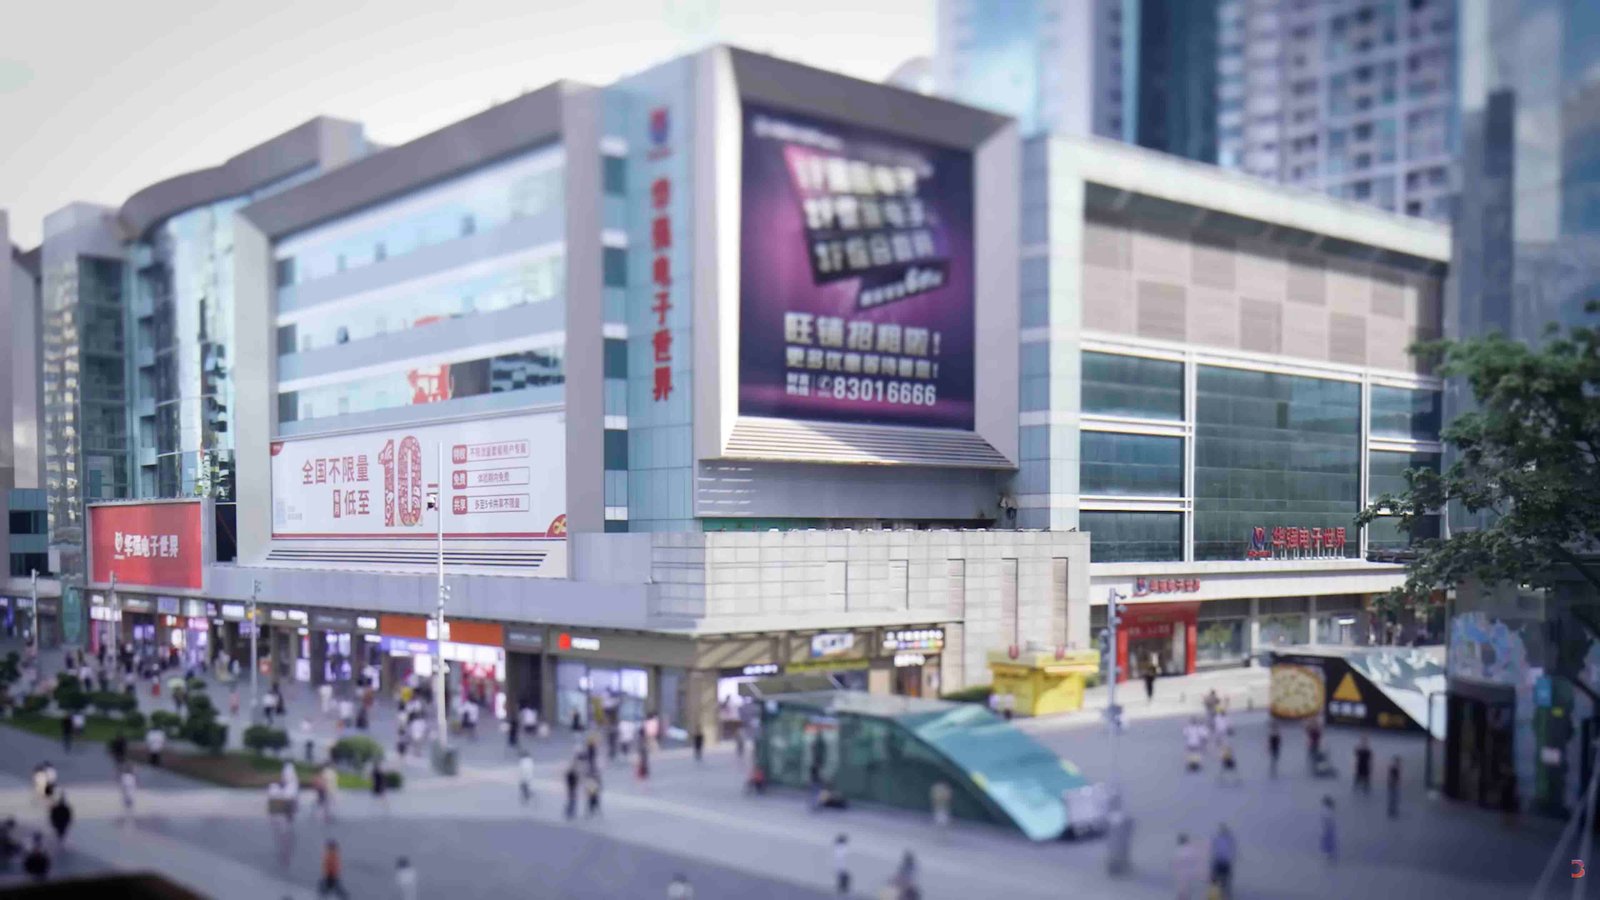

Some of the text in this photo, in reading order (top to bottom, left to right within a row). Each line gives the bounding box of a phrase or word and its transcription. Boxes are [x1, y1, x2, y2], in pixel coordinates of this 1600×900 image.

[833, 376, 937, 406] 83016666
[302, 455, 369, 485] 全国不限量
[378, 435, 422, 527] 10
[344, 489, 370, 516] 低至
[124, 534, 179, 558] 华强电子世界
[1272, 526, 1346, 549] 华强电子世界
